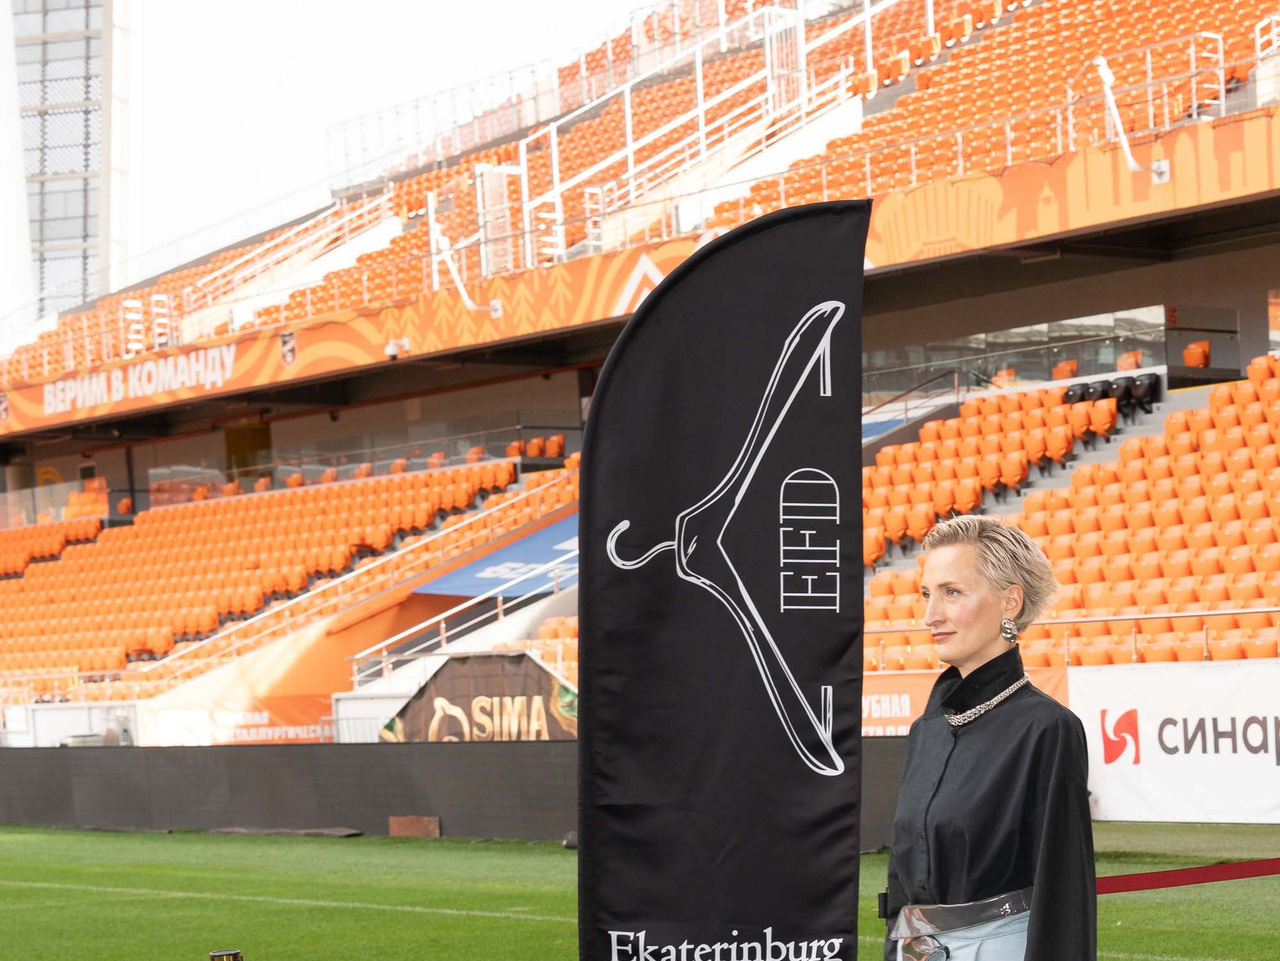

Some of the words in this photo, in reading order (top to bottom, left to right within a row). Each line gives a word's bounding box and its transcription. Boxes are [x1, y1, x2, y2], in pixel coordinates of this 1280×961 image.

[43, 371, 109, 416] ВЕРИМ
[109, 367, 125, 402] В
[128, 343, 237, 400] КОМАНДУ
[779, 467, 840, 614] EFD
[471, 695, 550, 741] SIMA
[861, 693, 911, 719] УБНАЯ
